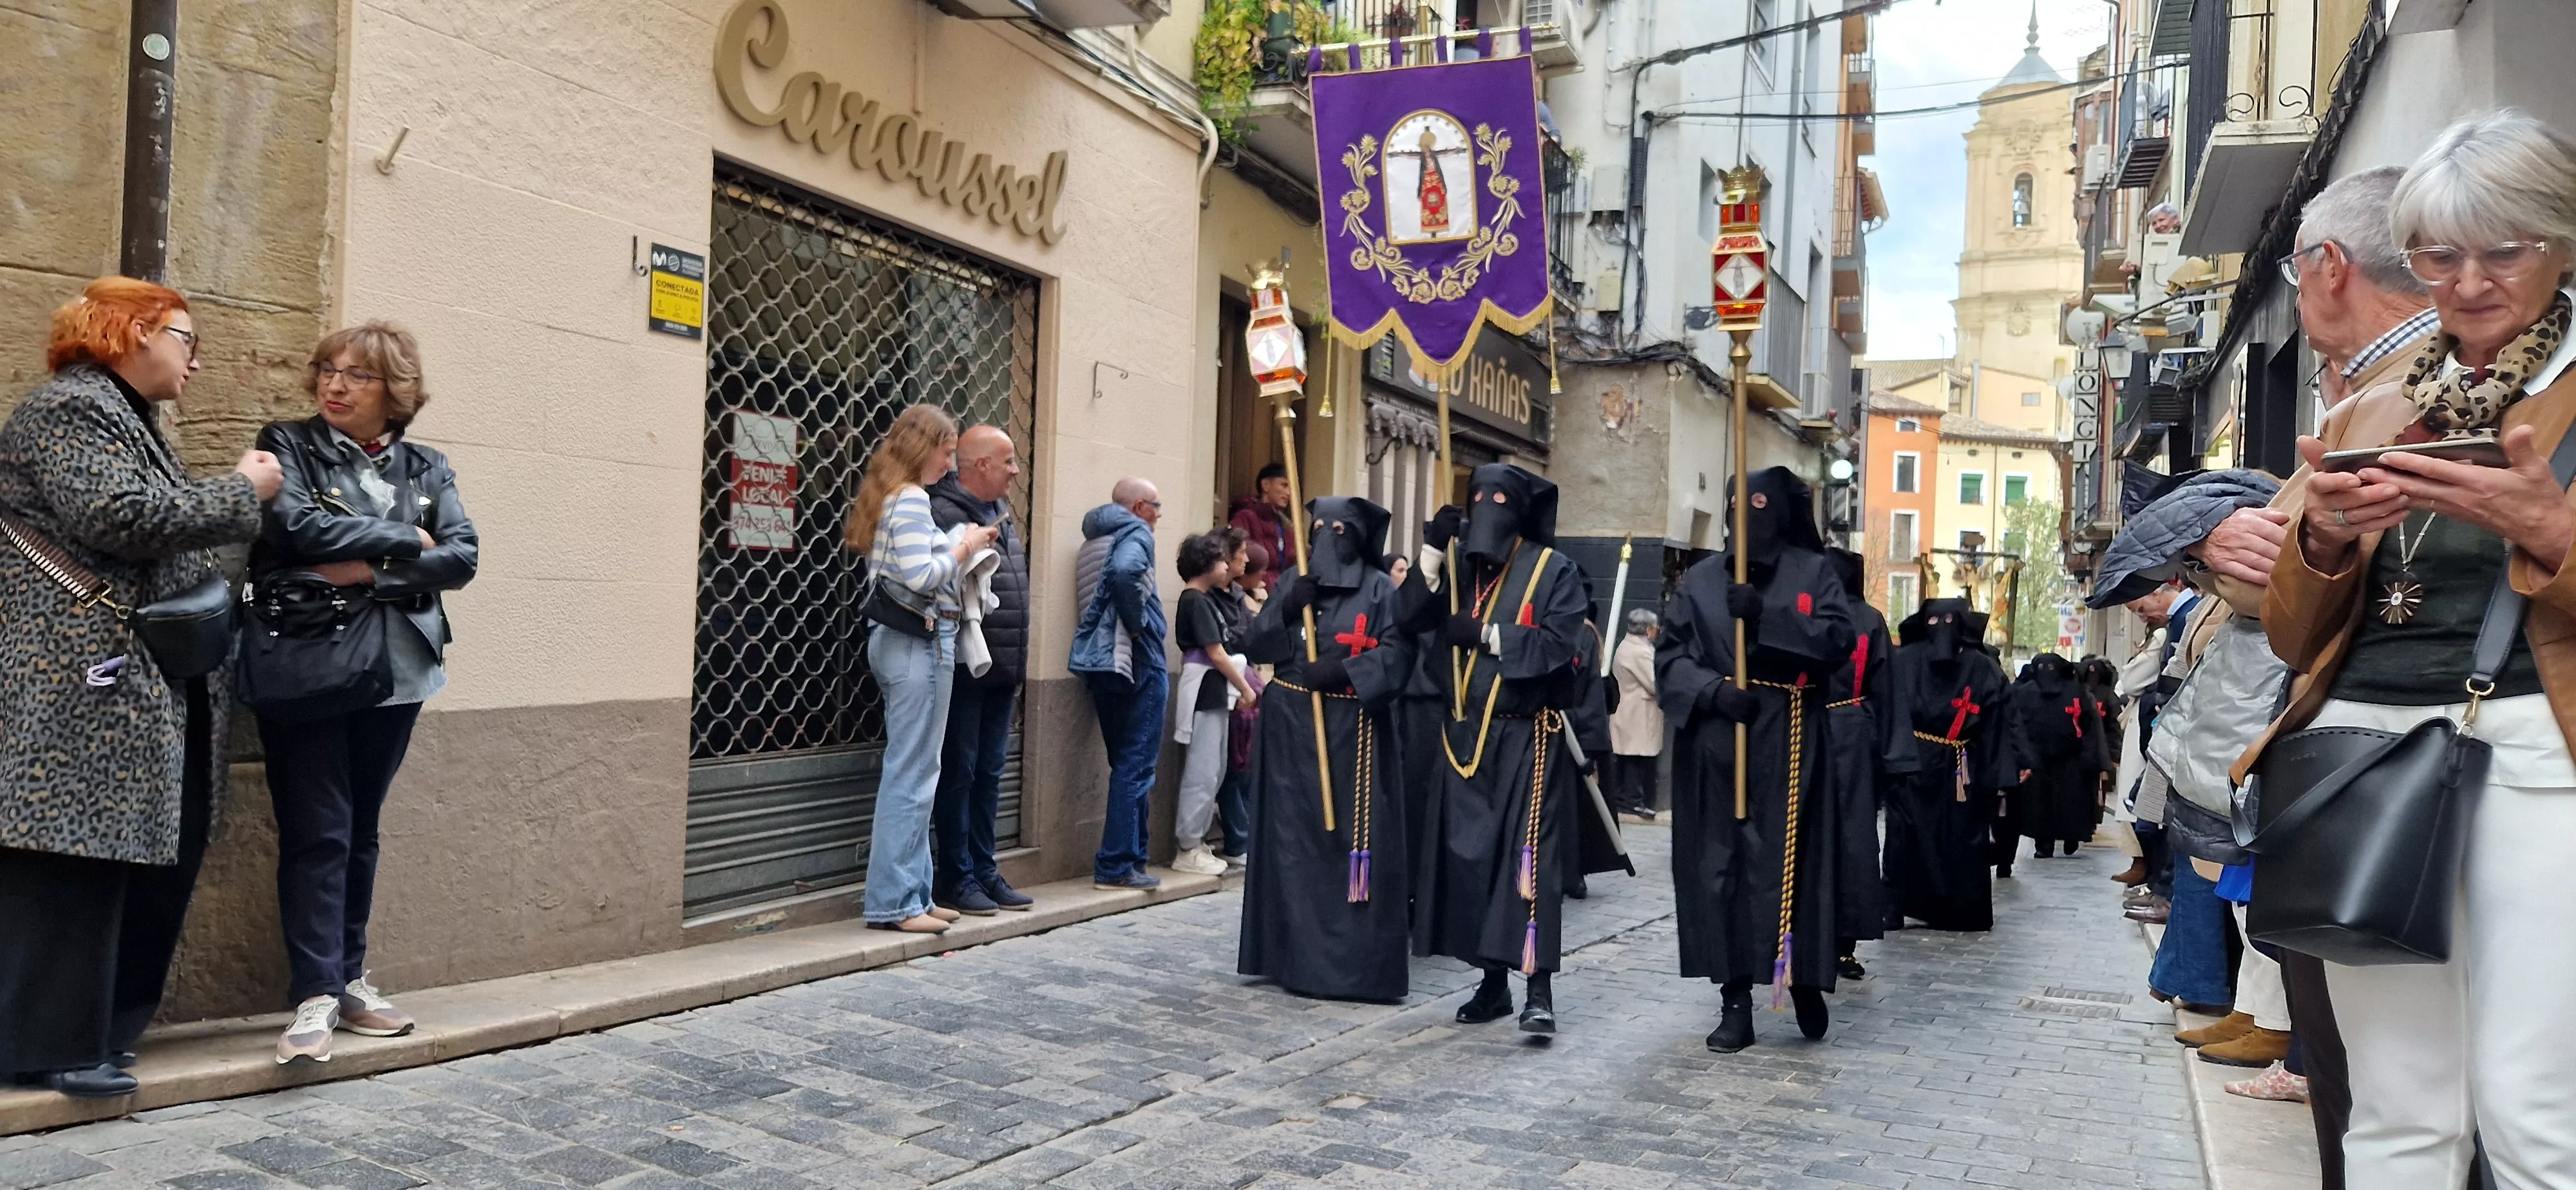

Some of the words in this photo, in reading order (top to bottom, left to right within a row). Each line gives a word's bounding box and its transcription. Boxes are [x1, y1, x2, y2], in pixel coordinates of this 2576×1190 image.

[714, 0, 1068, 245] Caroussel
[656, 279, 699, 296] CONECTADA
[742, 485, 783, 505] LOCAL
